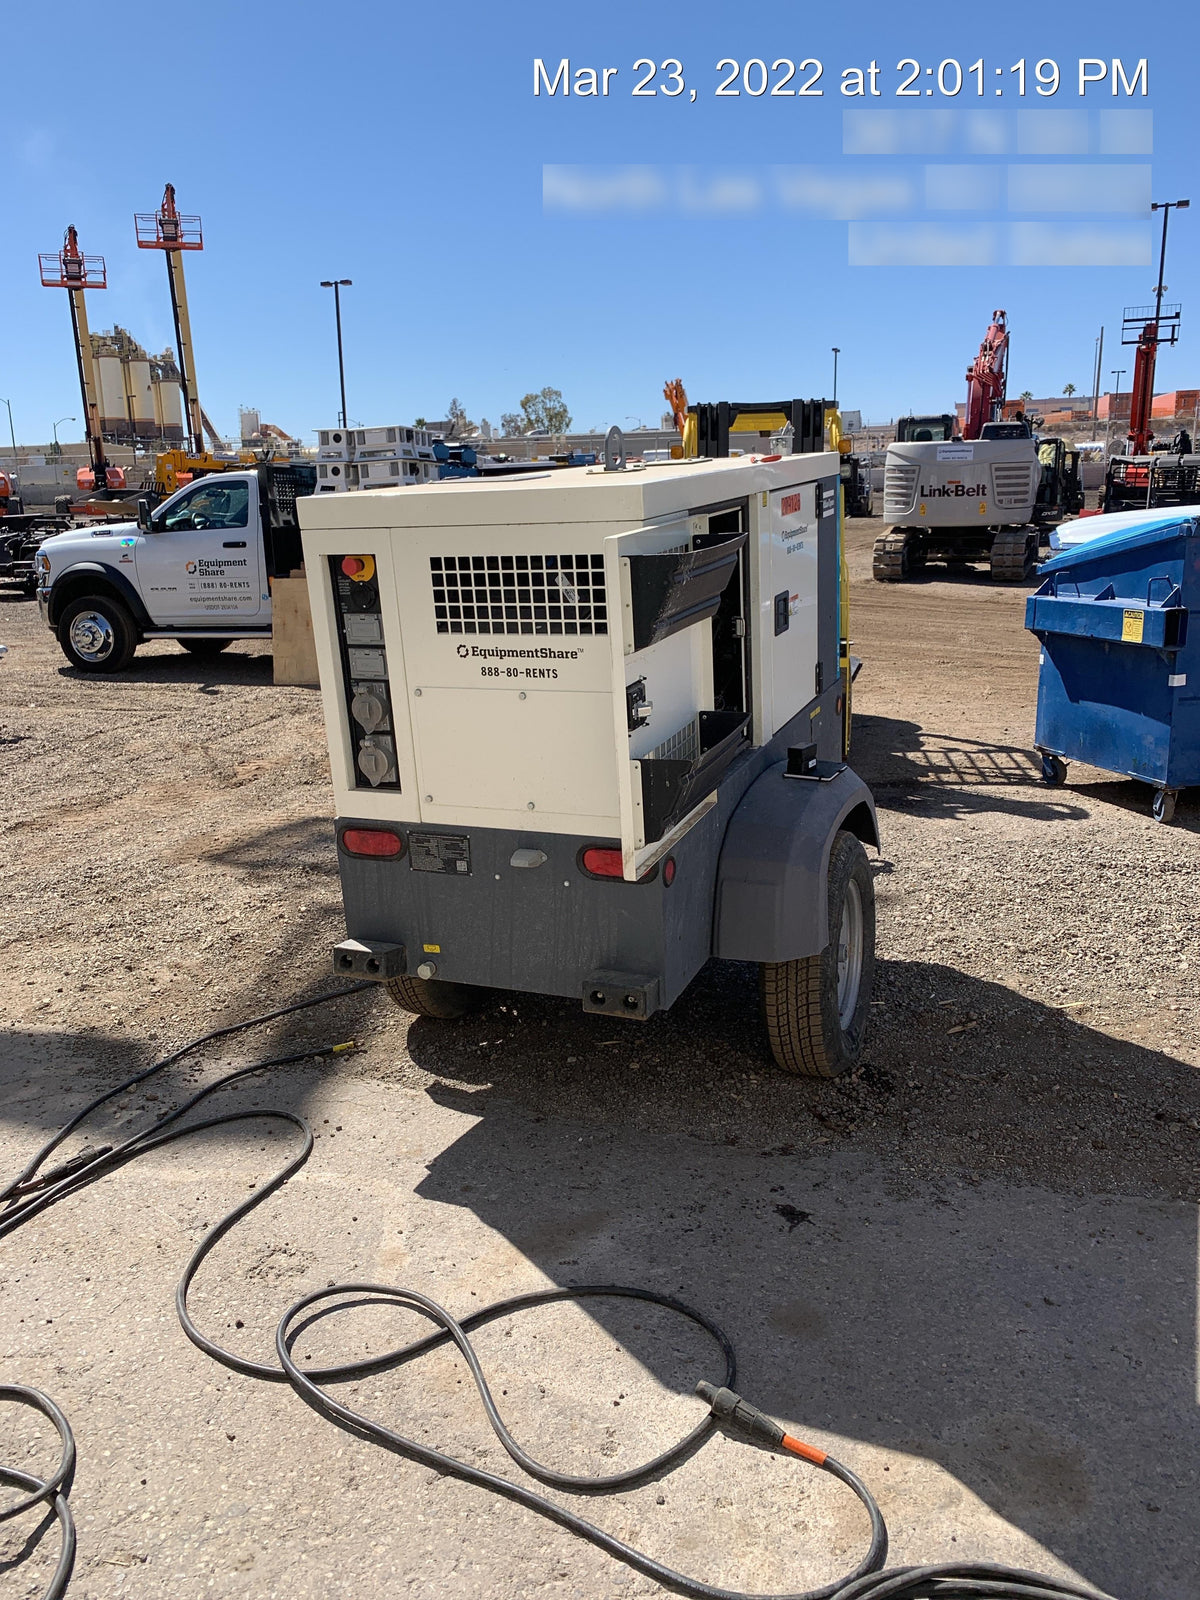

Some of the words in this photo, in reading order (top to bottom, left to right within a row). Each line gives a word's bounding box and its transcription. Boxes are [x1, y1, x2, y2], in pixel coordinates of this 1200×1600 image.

[919, 483, 988, 499] Link-Belt
[198, 559, 248, 568] Equipment
[198, 568, 225, 577] Share
[199, 581, 218, 590] (888)
[219, 580, 251, 590] 80-RENTS
[189, 595, 253, 603] equipmentshare.com
[480, 666, 559, 679] 888-80-RENTS
